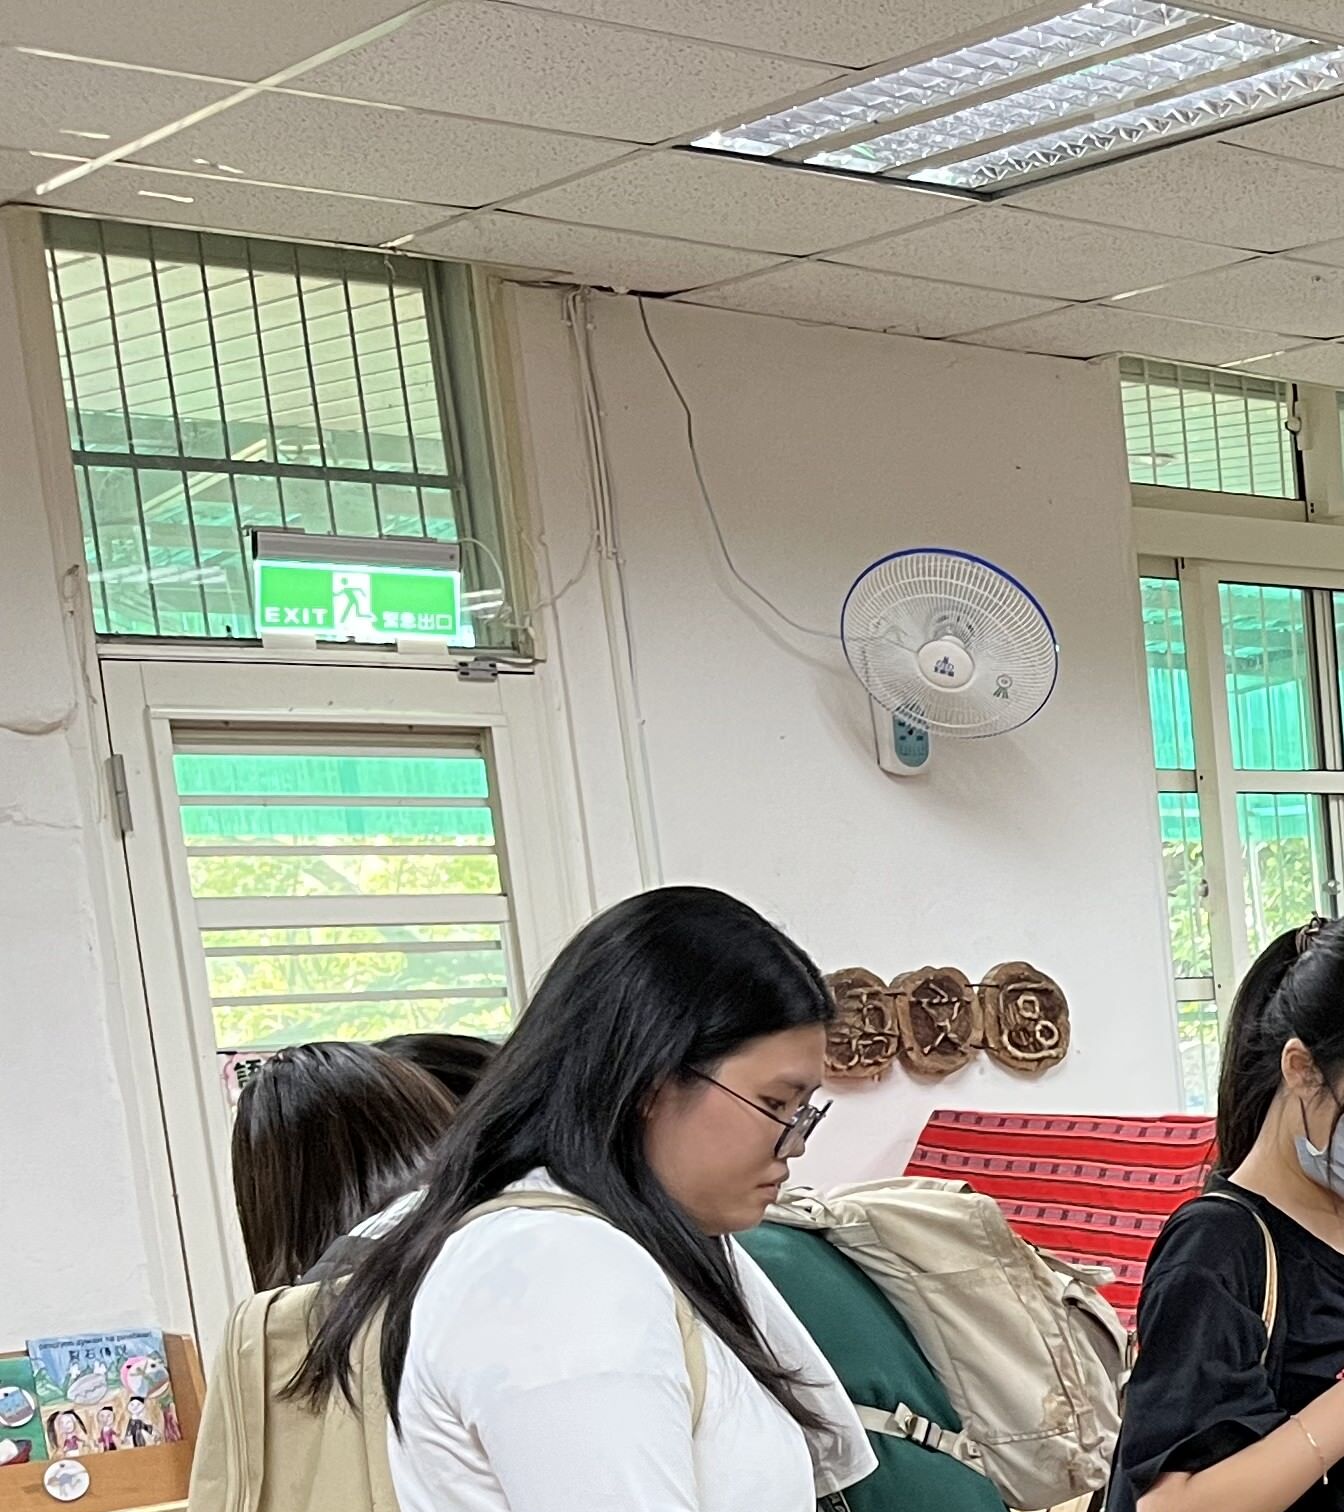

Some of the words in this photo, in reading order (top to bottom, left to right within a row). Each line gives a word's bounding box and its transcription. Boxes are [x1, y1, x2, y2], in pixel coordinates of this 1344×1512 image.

[265, 606, 329, 626] EXIT
[382, 610, 453, 631] 緊急出口
